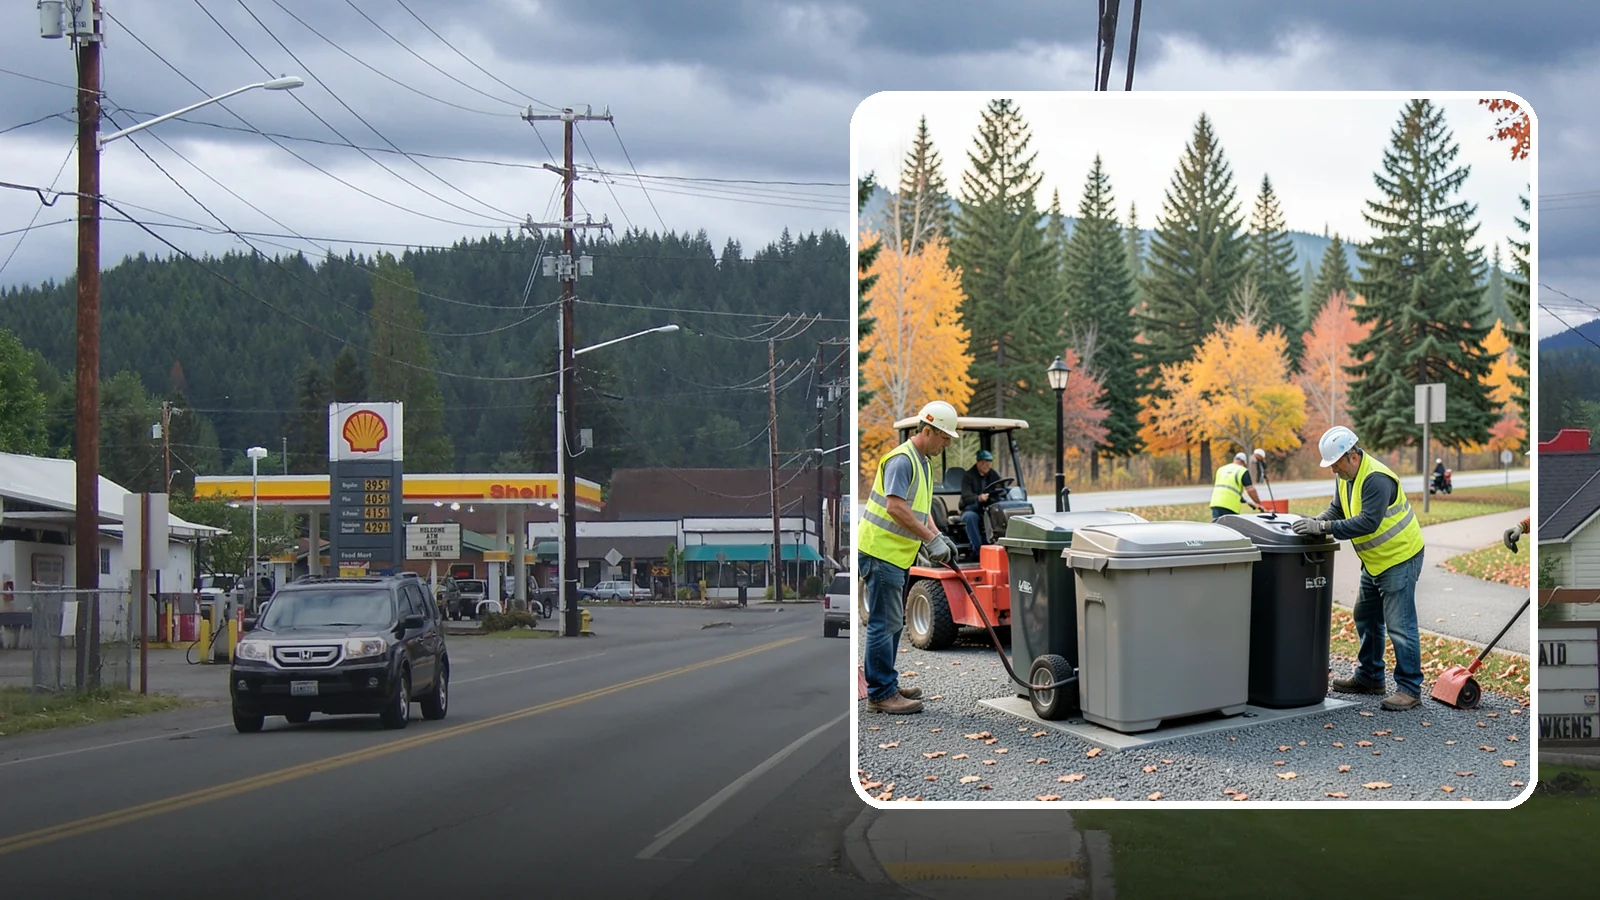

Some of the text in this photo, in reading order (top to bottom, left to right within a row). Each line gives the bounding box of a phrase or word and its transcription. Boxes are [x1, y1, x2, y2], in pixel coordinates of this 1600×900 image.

[366, 480, 383, 490] 395
[490, 484, 547, 498] Shell
[366, 494, 383, 504] 405
[366, 508, 383, 518] 415
[366, 522, 383, 532] 429
